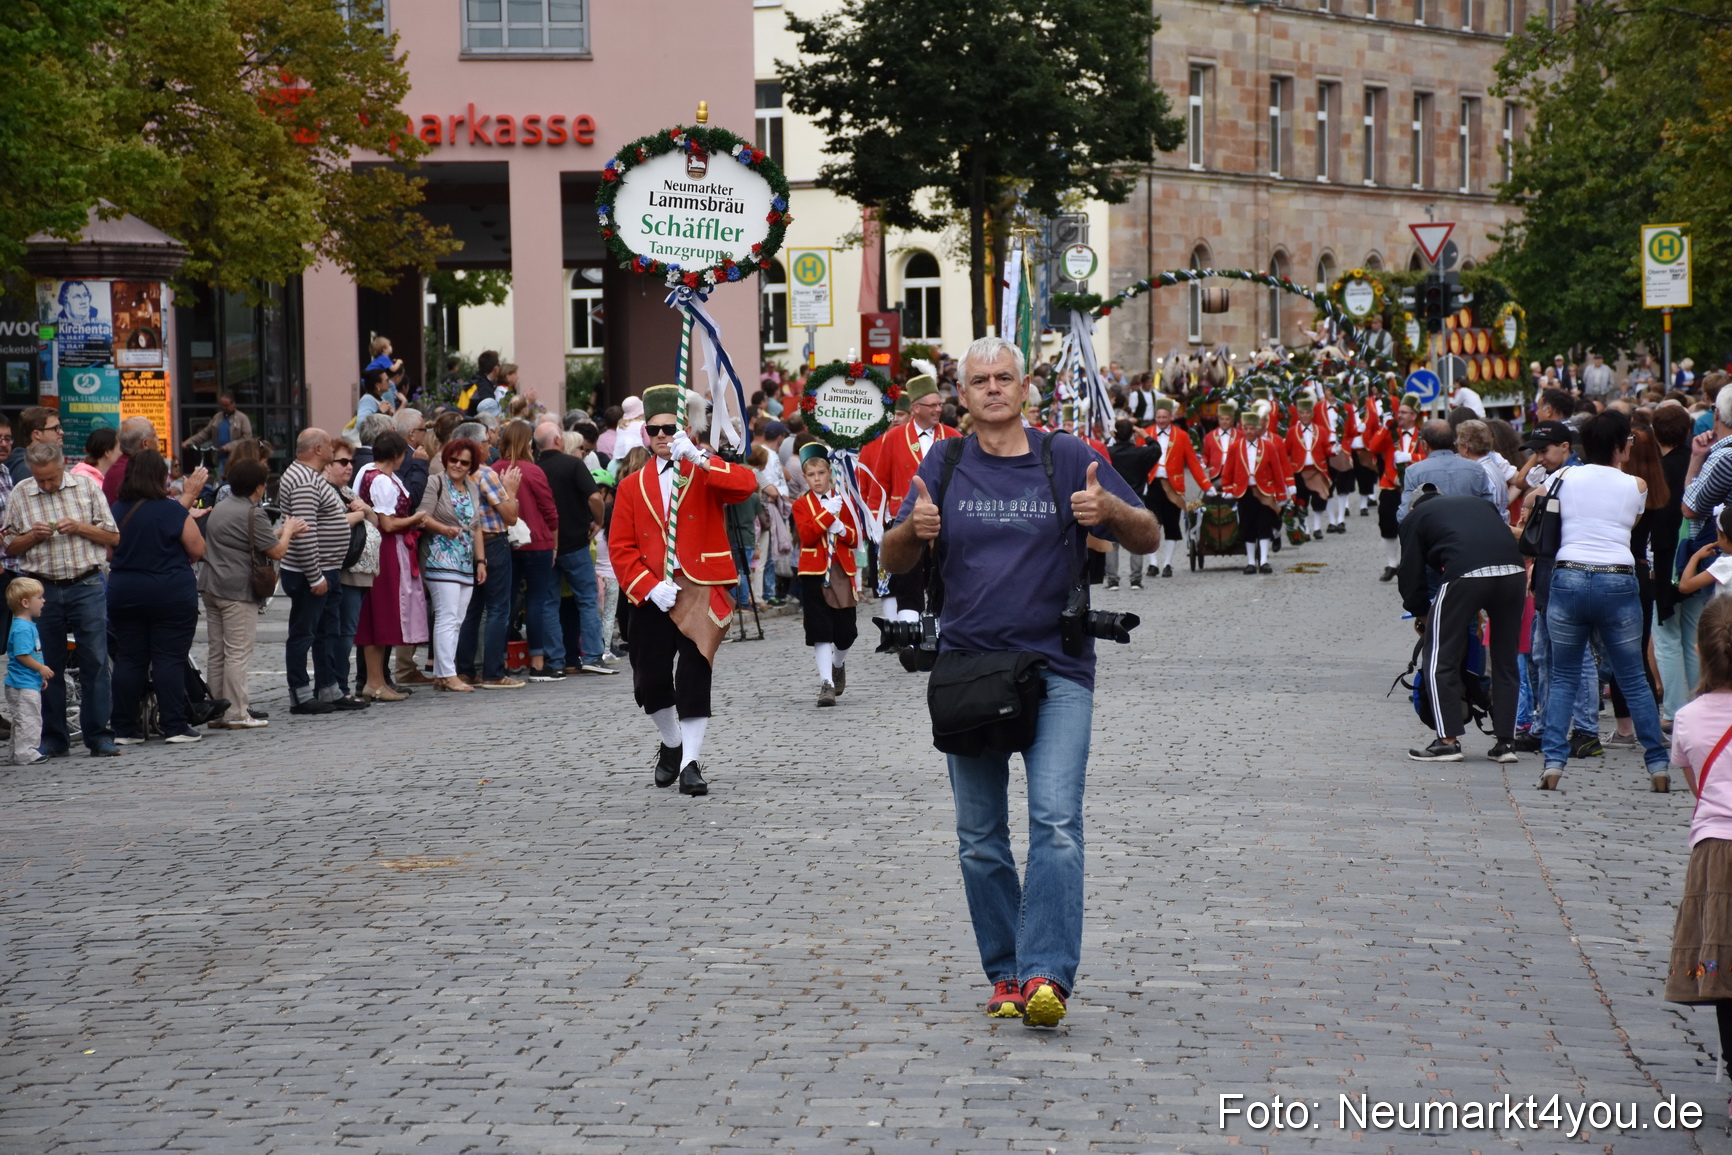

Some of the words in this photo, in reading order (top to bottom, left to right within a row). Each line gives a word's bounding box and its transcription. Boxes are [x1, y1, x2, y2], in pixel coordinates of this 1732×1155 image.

[663, 180, 734, 196] Neumarkter
[649, 191, 744, 214] Lammsbräu
[641, 213, 744, 242] Schäffler
[121, 379, 165, 387] VOLKSFEST
[831, 387, 868, 395] Neumarkter
[823, 393, 873, 405] Lammsbräu
[817, 406, 876, 421] Schäffler-
[832, 421, 860, 434] Tanz
[958, 500, 1005, 511] FOSSIL
[1010, 500, 1057, 514] BRAND
